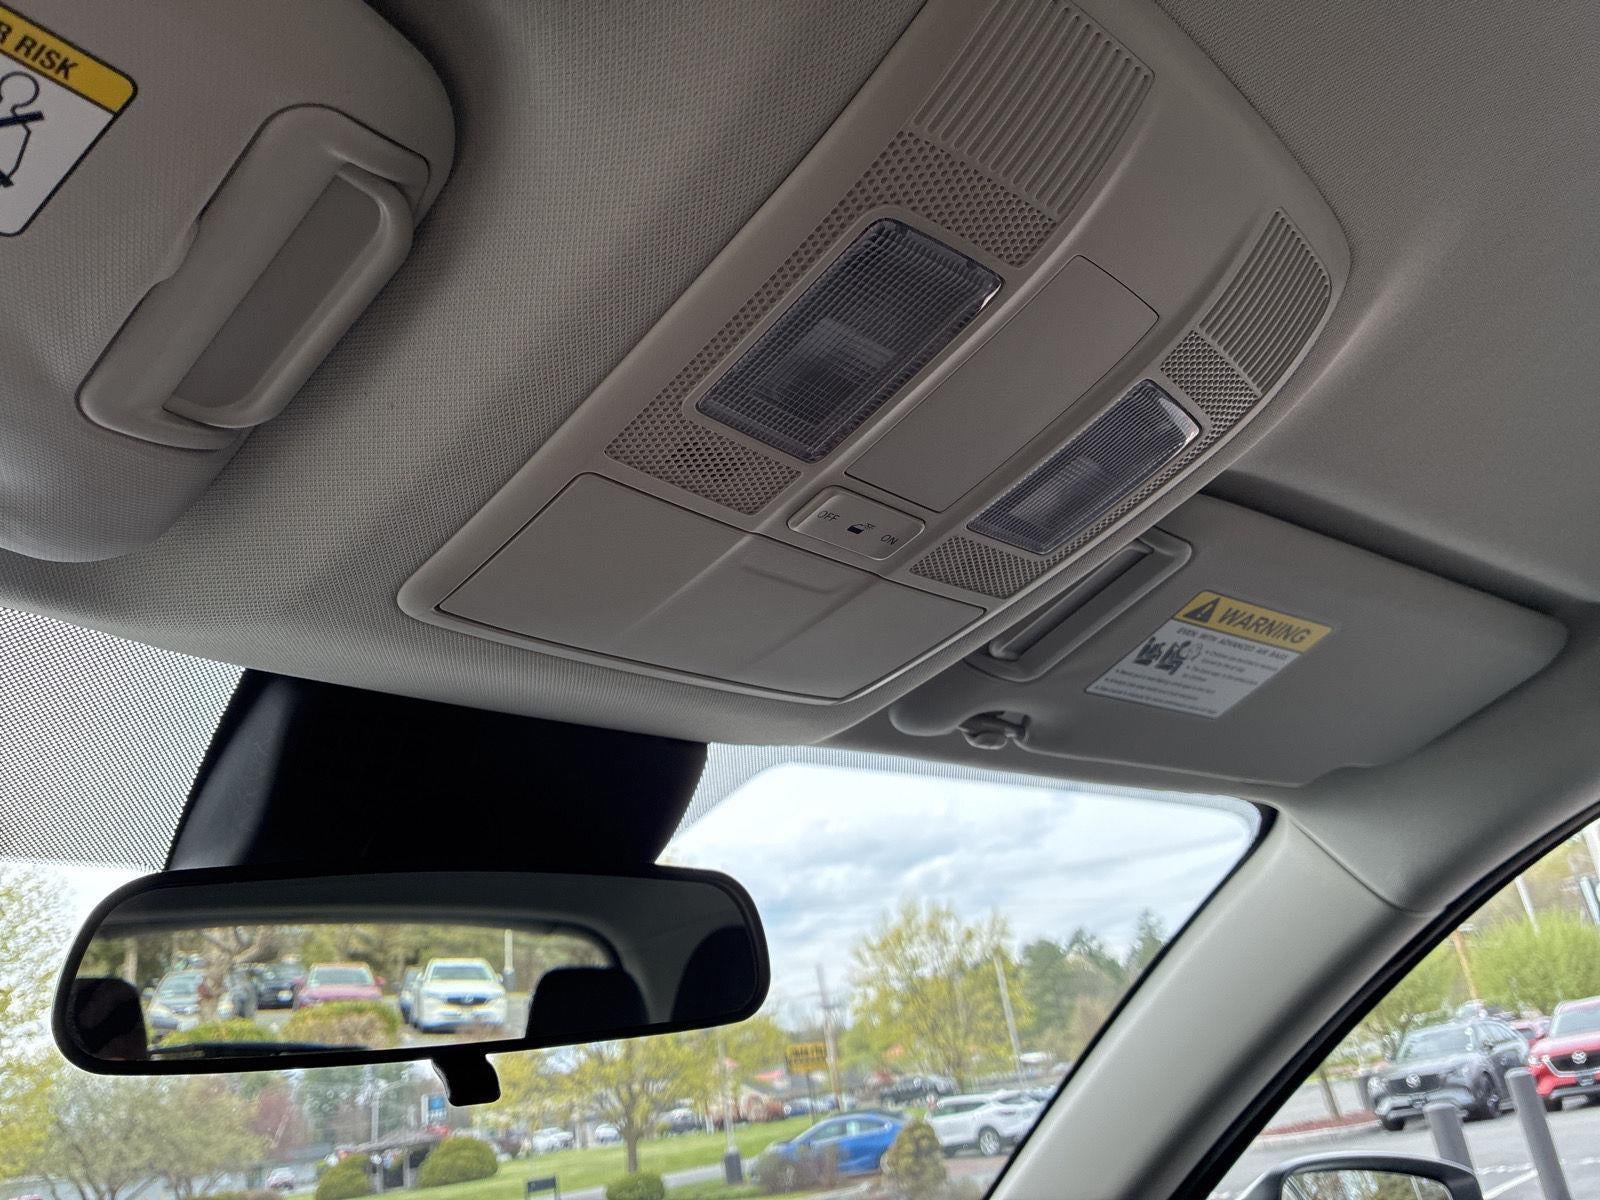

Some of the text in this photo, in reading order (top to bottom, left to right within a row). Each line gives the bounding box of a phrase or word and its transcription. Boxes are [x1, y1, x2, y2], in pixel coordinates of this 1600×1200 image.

[14, 34, 79, 80] RISK
[817, 510, 840, 522] OFF
[880, 534, 899, 546] ON
[1218, 606, 1311, 644] WARNING
